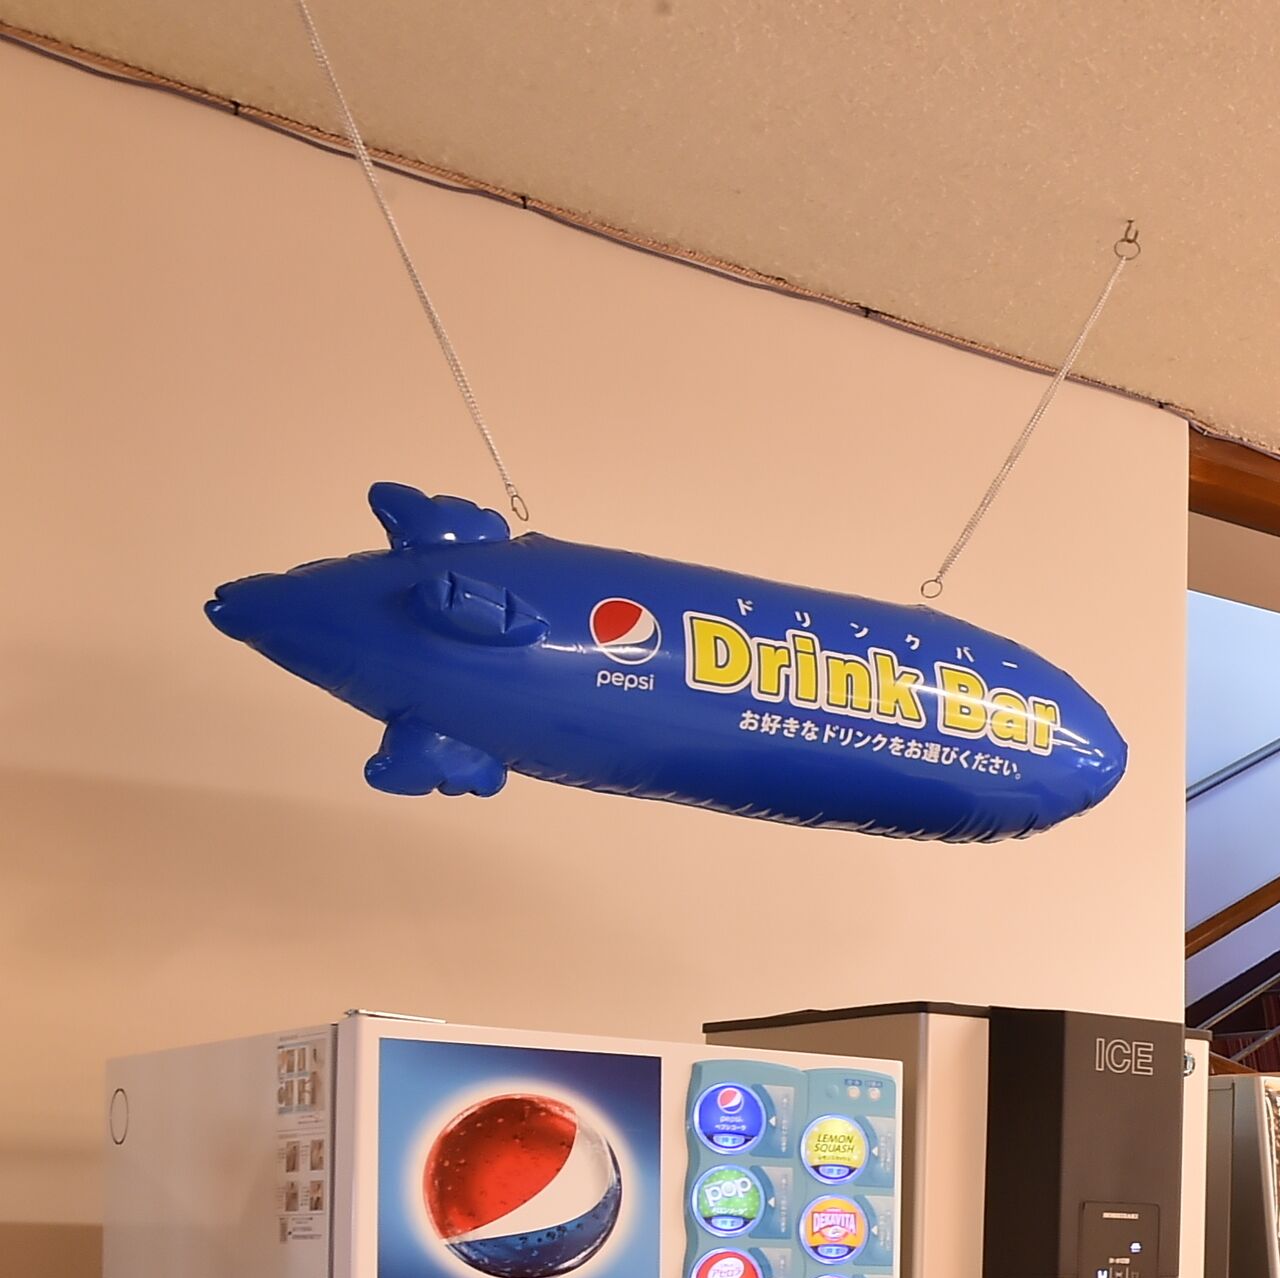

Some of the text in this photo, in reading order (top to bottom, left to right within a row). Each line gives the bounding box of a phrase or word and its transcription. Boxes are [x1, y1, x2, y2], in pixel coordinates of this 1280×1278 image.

[736, 597, 1018, 669] ドリンクバー
[596, 669, 655, 691] pepsi
[685, 612, 1059, 755] Drink Bar
[738, 709, 1023, 780] お好きなドリンクをお選びください。
[1094, 1038, 1154, 1076] ICE
[814, 1143, 855, 1154] SQUASH
[817, 1133, 853, 1144] LEMON
[704, 1176, 752, 1207] pop
